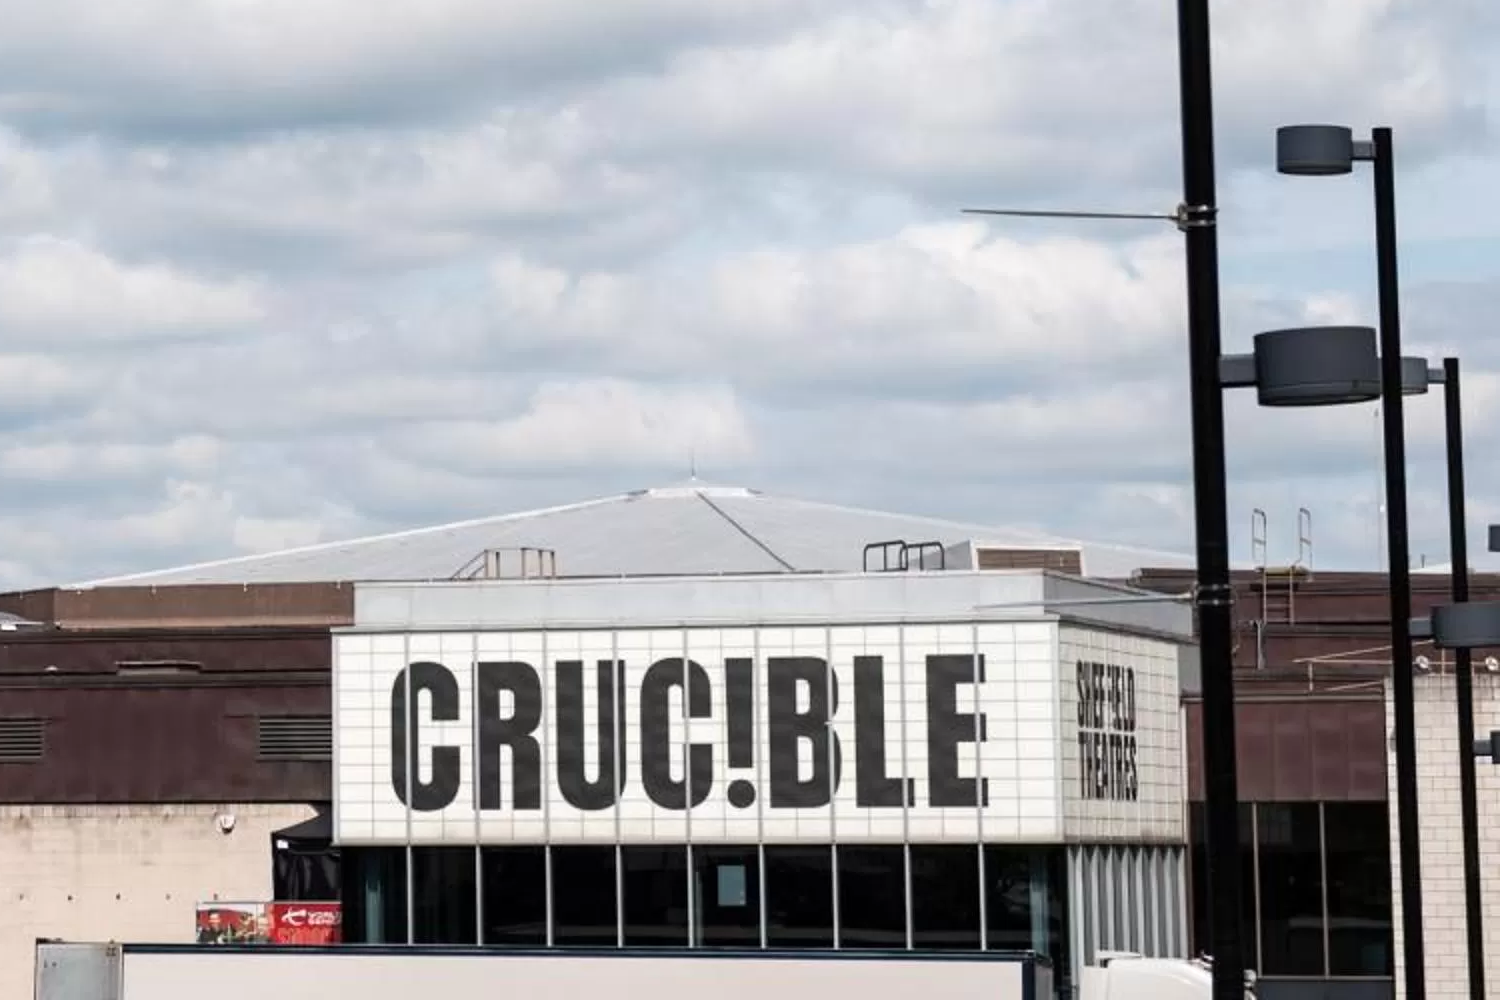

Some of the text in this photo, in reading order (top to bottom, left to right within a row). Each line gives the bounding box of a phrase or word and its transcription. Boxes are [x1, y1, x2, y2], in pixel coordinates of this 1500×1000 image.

[391, 653, 989, 811] CRUC!BLE
[1076, 659, 1136, 732] SHEFFIELD
[1078, 731, 1138, 802] THEATRES
